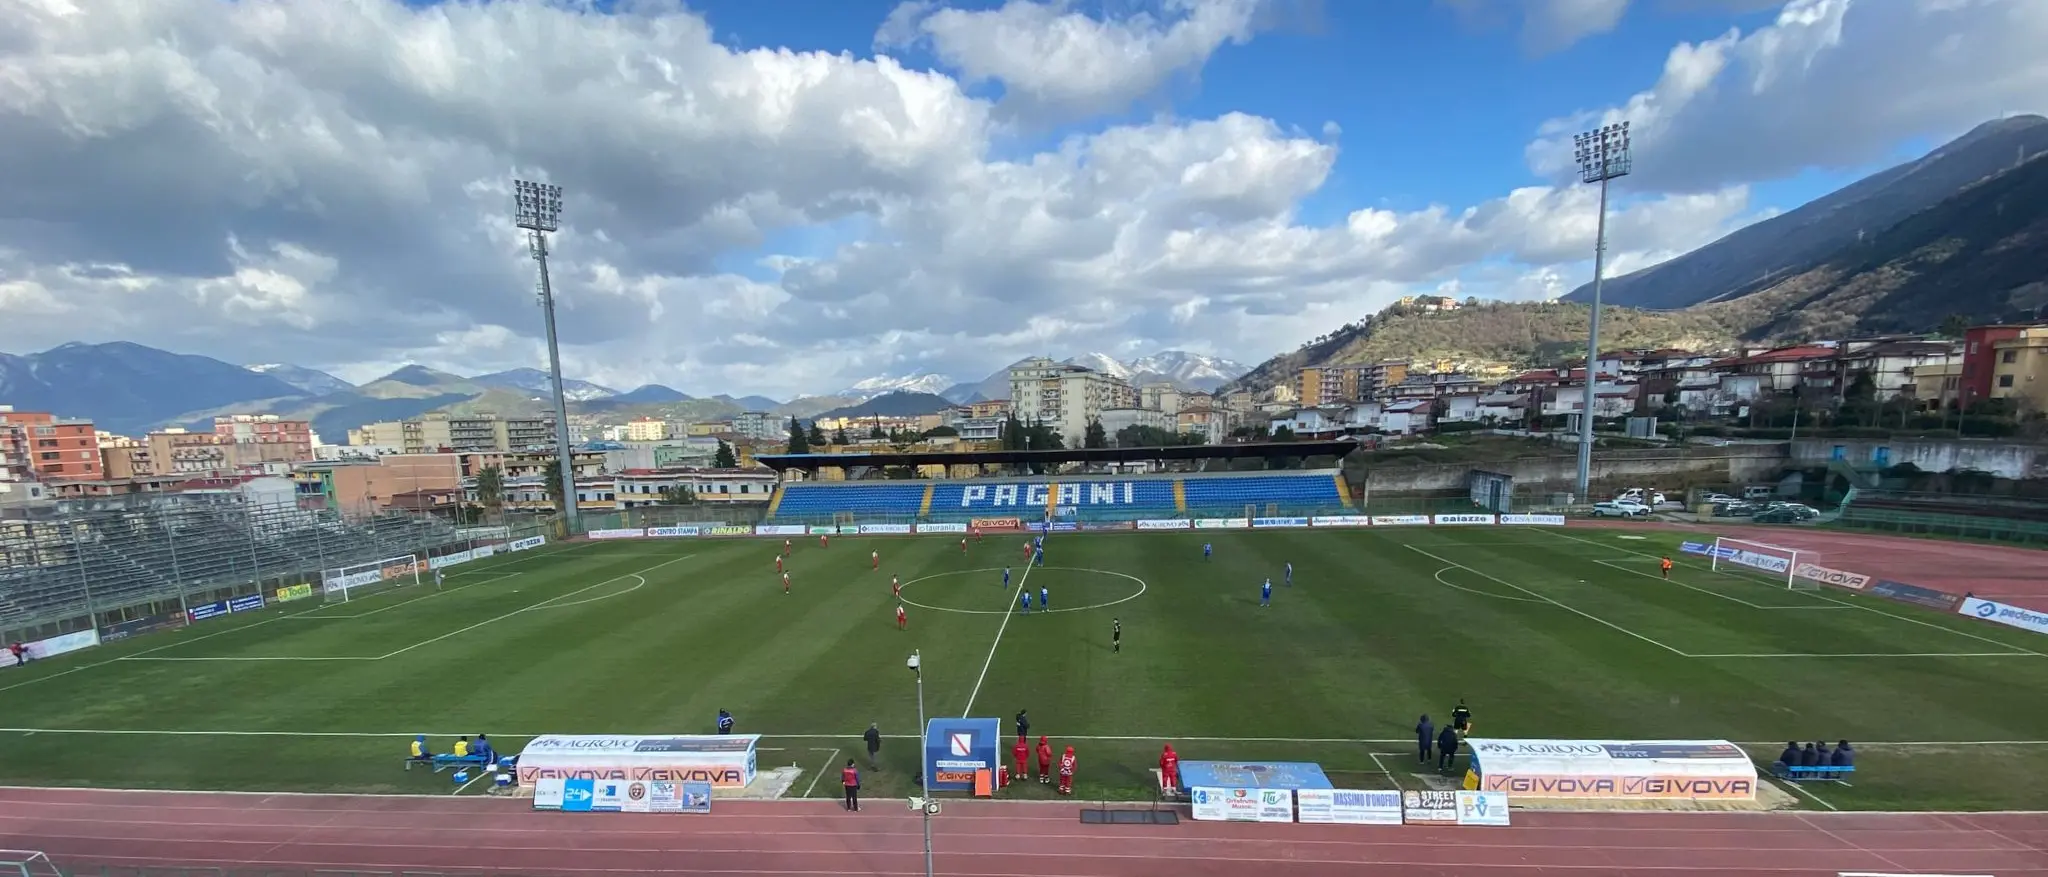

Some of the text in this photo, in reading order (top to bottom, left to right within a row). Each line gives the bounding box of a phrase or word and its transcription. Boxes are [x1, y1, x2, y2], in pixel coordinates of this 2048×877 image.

[961, 482, 1133, 507] PAGANI
[657, 527, 698, 535] CENTRO STAMPA
[712, 527, 750, 535] RINALDO
[1807, 565, 1863, 587] GIVOVA
[564, 738, 638, 748] AGROVO
[1517, 743, 1602, 754] AGROVO
[652, 769, 740, 782] GIVOVA
[1510, 778, 1614, 793] GIVOVA
[1645, 779, 1750, 794] GIVOVA
[1333, 792, 1365, 806] MASSIMO
[1366, 793, 1400, 807] D'ONOFRIO
[1421, 790, 1455, 800] STREET
[1422, 800, 1455, 808] Coffee
